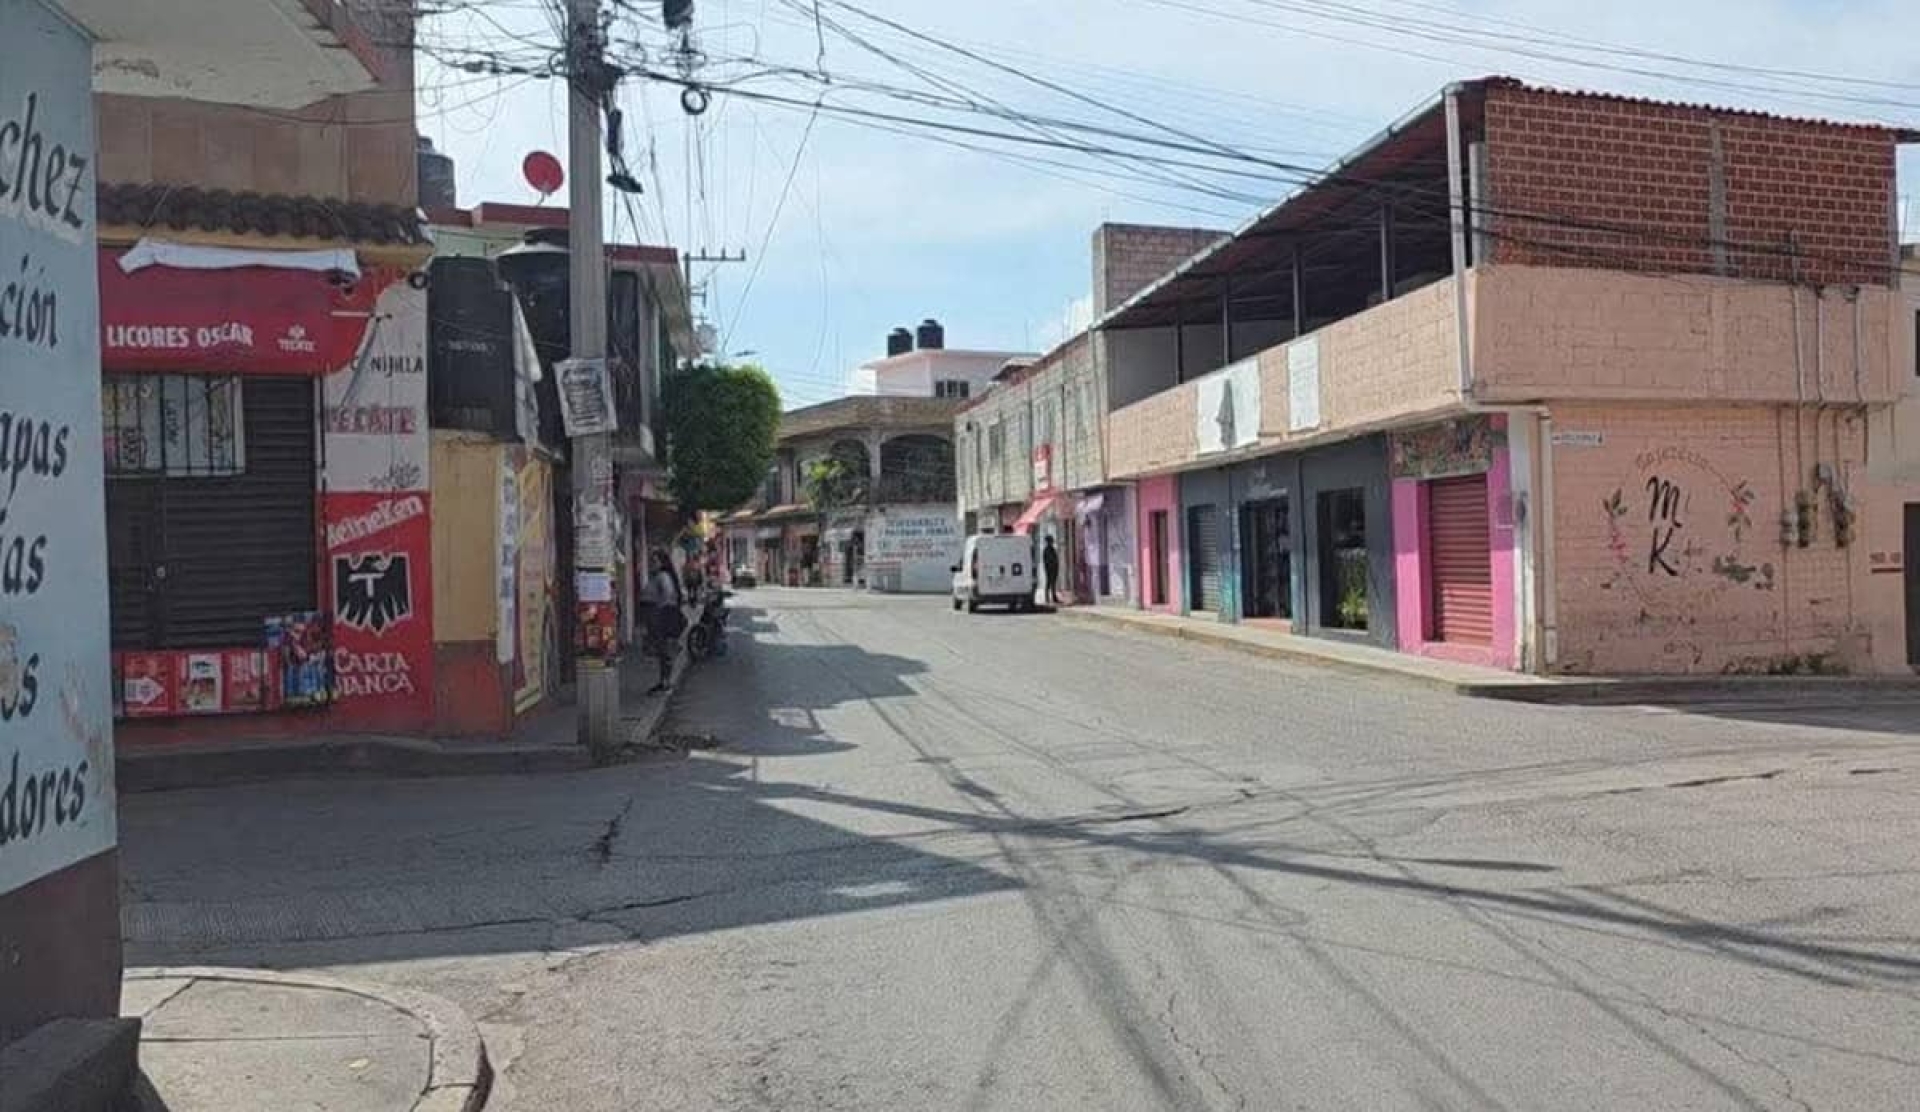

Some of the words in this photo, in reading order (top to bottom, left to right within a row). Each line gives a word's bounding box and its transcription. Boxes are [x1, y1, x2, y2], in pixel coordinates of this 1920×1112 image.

[106, 325, 190, 348] LICORES
[197, 322, 254, 347] OSCAR
[334, 647, 411, 674] CARTA
